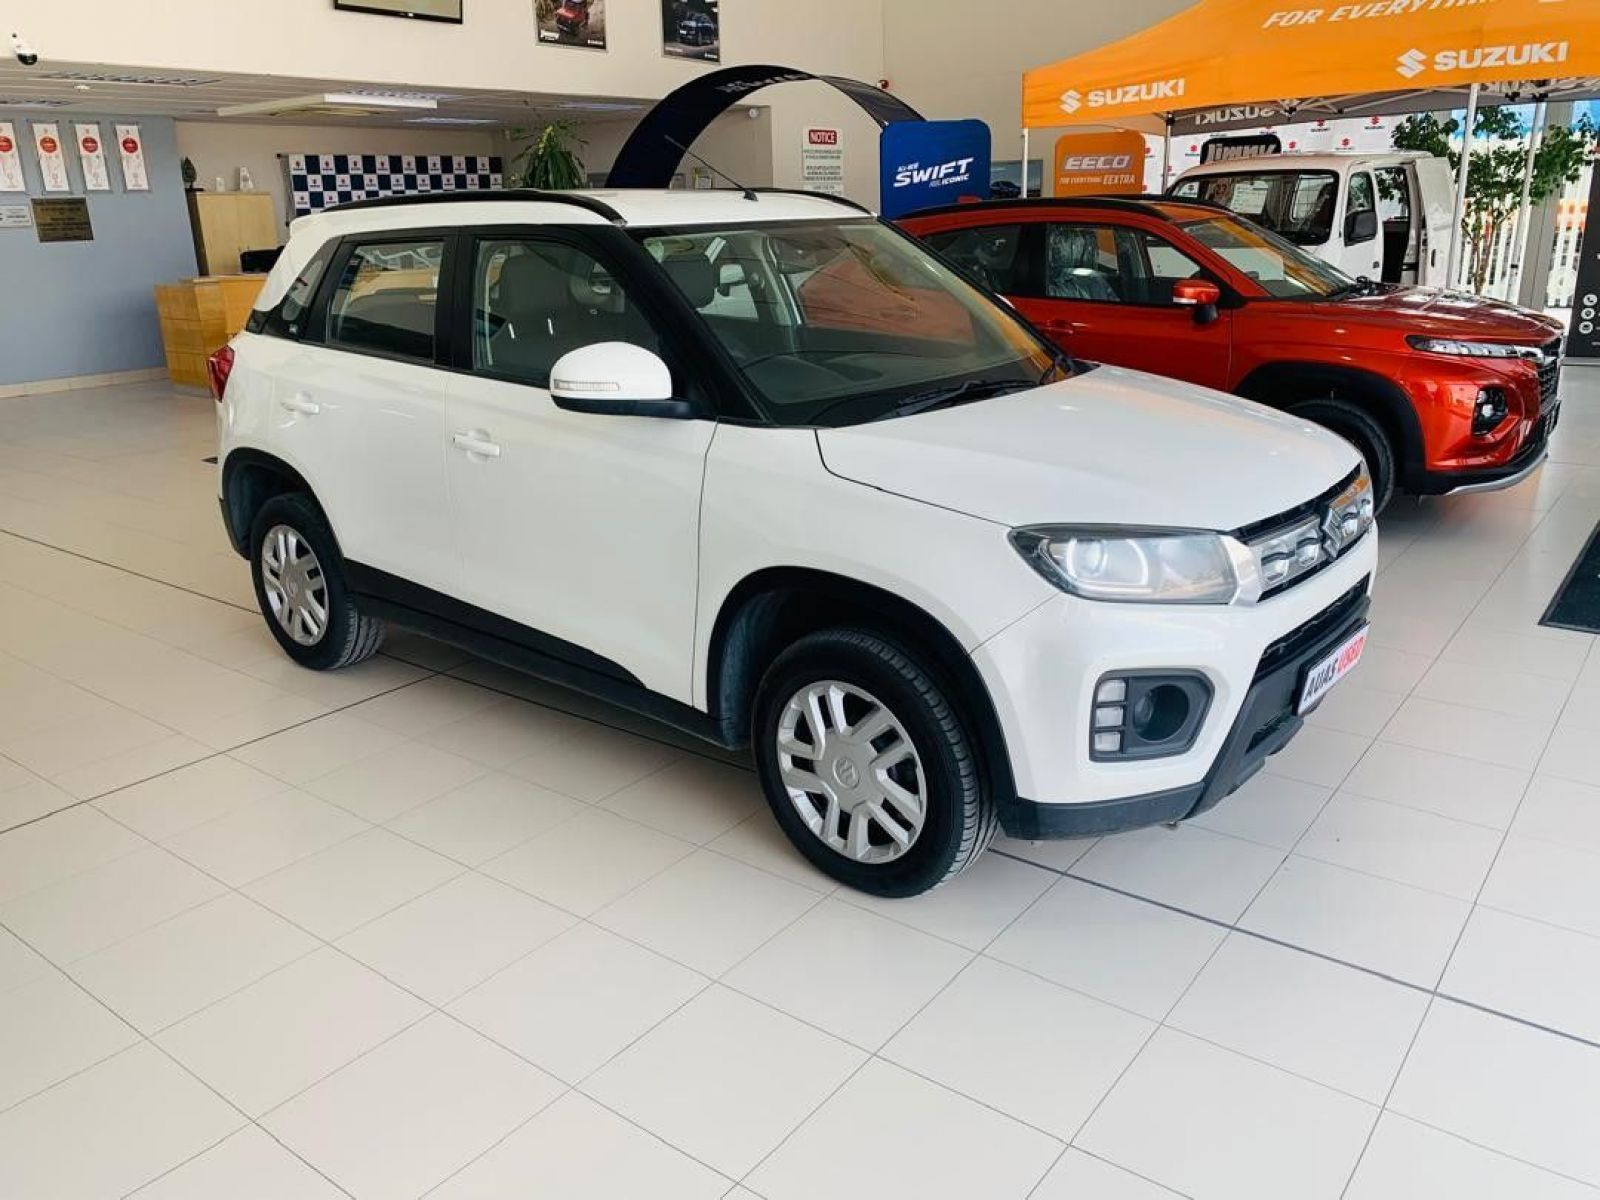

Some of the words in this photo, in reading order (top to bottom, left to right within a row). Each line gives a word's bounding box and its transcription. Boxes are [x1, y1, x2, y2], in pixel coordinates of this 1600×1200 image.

[1262, 9, 1324, 29] FOR
[1327, 0, 1492, 22] EVERYT
[1433, 41, 1569, 72] SUZUKI
[1087, 78, 1186, 108] SUZUKI
[810, 131, 835, 143] NOTICE
[893, 157, 974, 188] SWIFT
[1064, 155, 1132, 170] EECO
